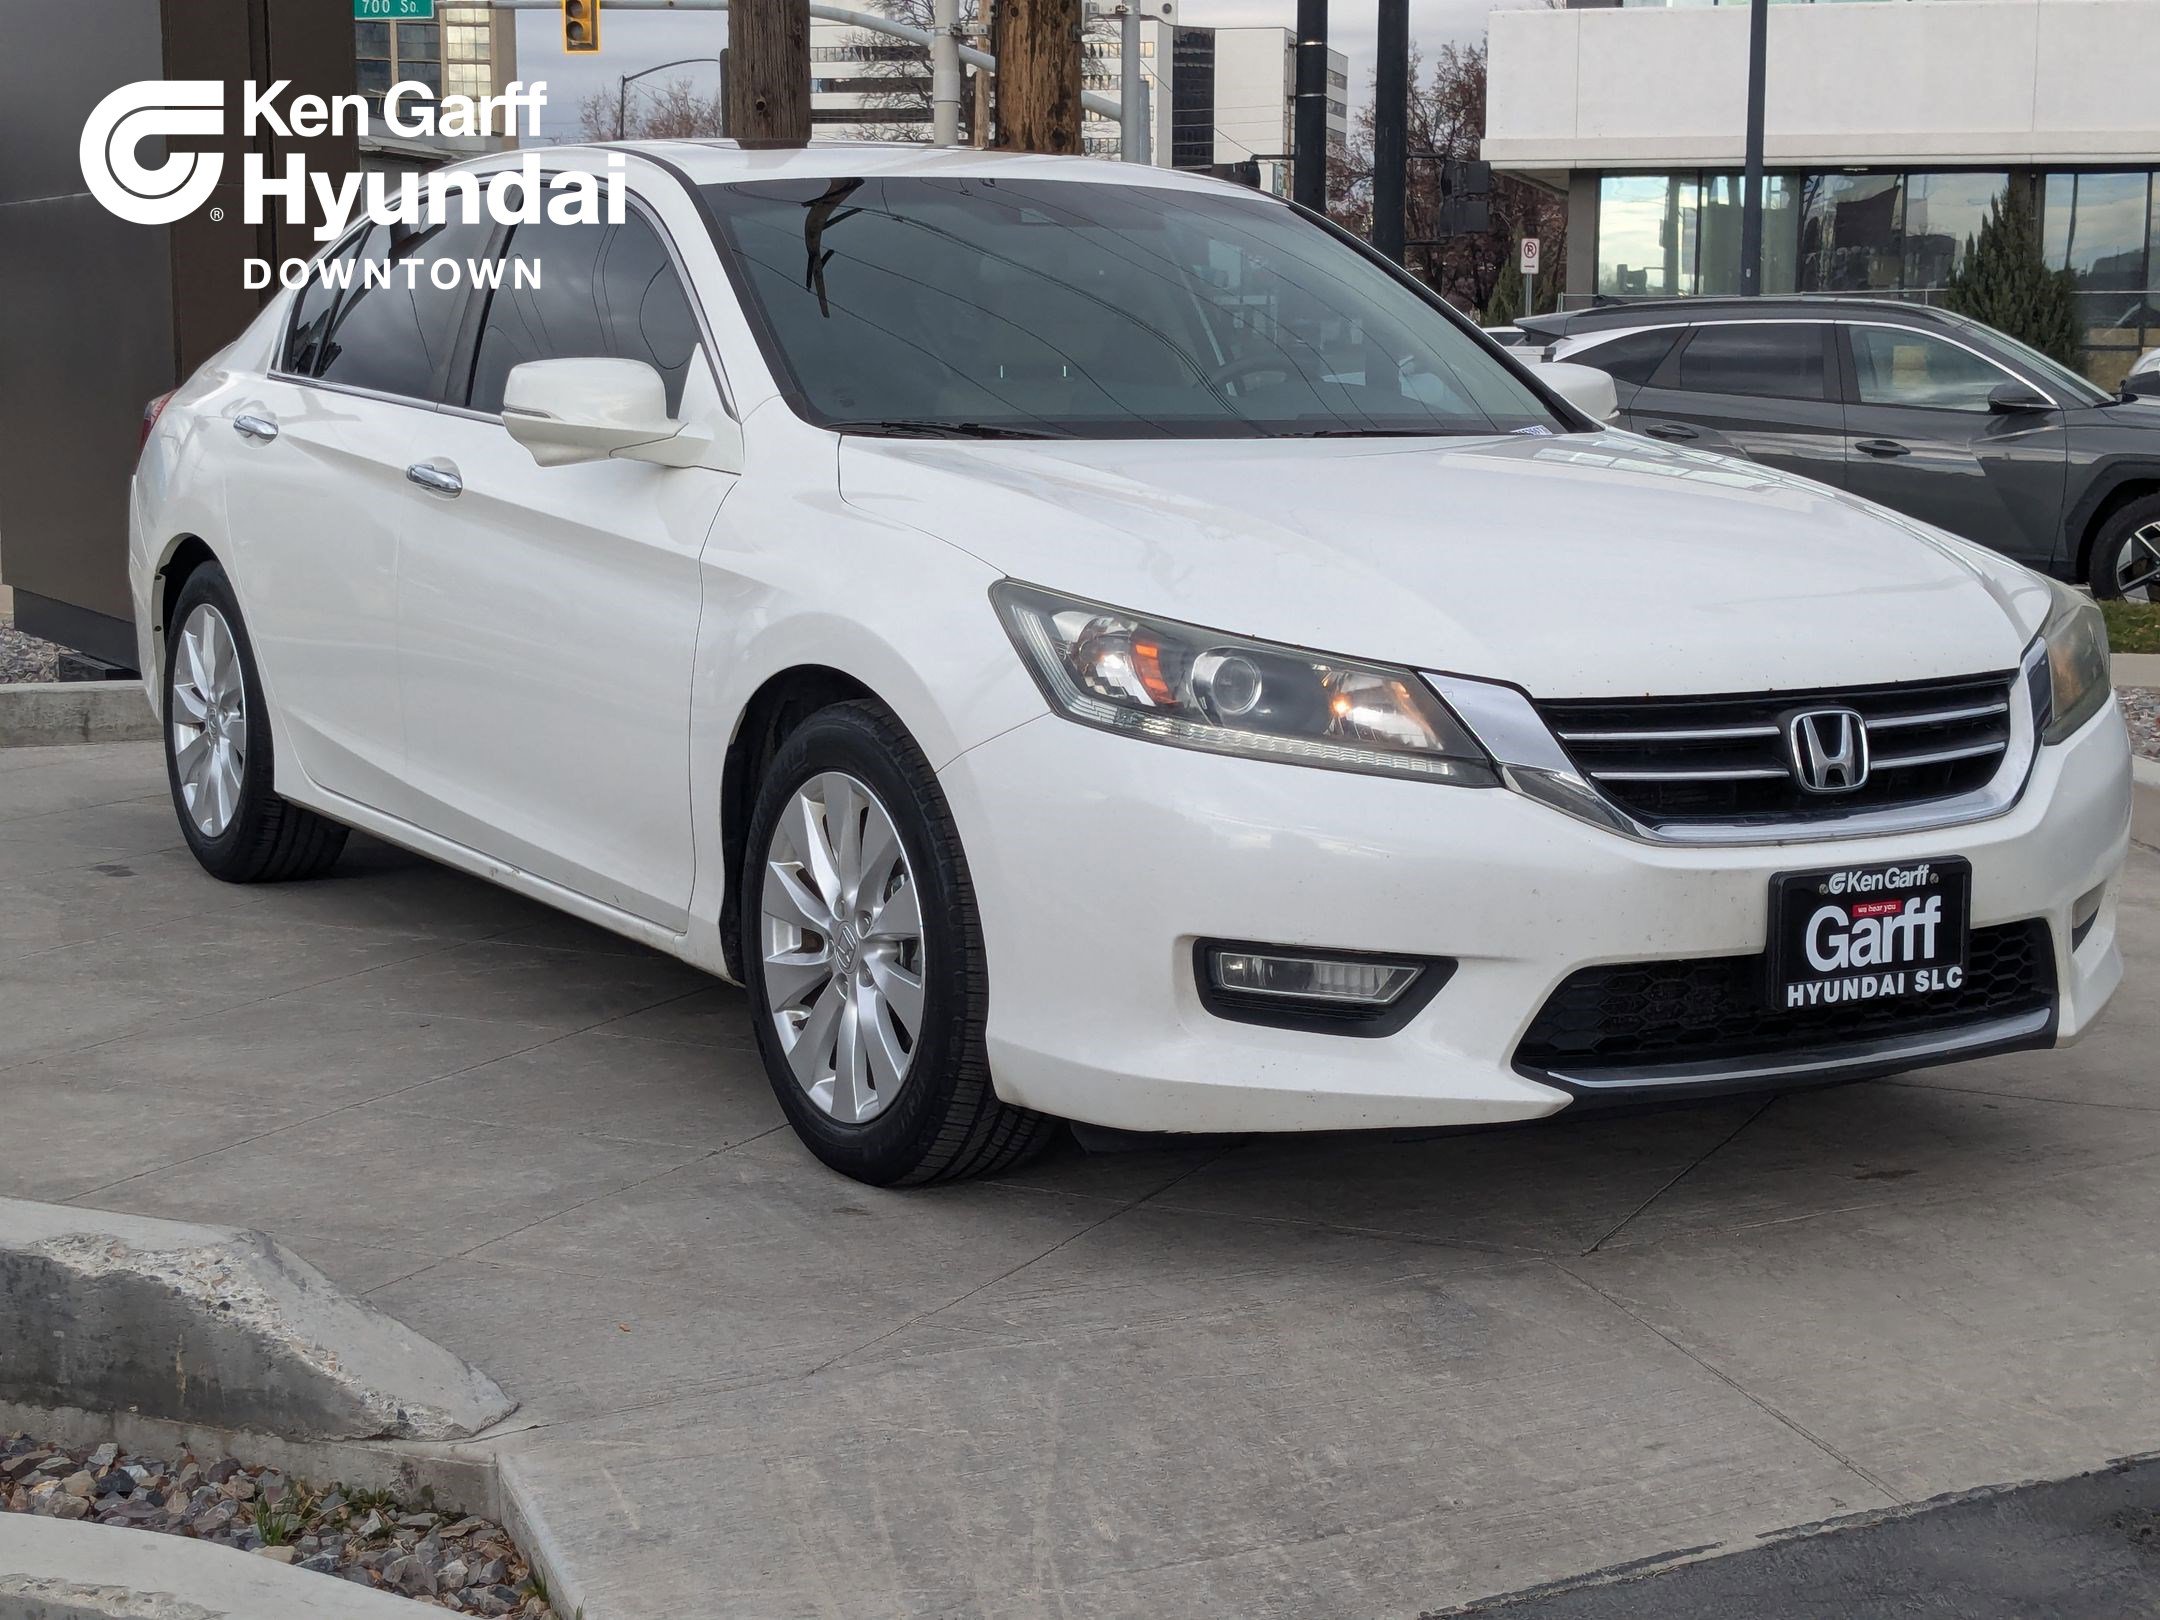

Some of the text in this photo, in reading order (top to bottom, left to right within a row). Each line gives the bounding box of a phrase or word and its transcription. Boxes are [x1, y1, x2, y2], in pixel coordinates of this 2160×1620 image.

[363, 0, 391, 14] 700
[1846, 864, 1930, 893] Ken Garff
[1805, 895, 1942, 973] Garff
[1787, 966, 1964, 1008] HYUNDAI SLC
